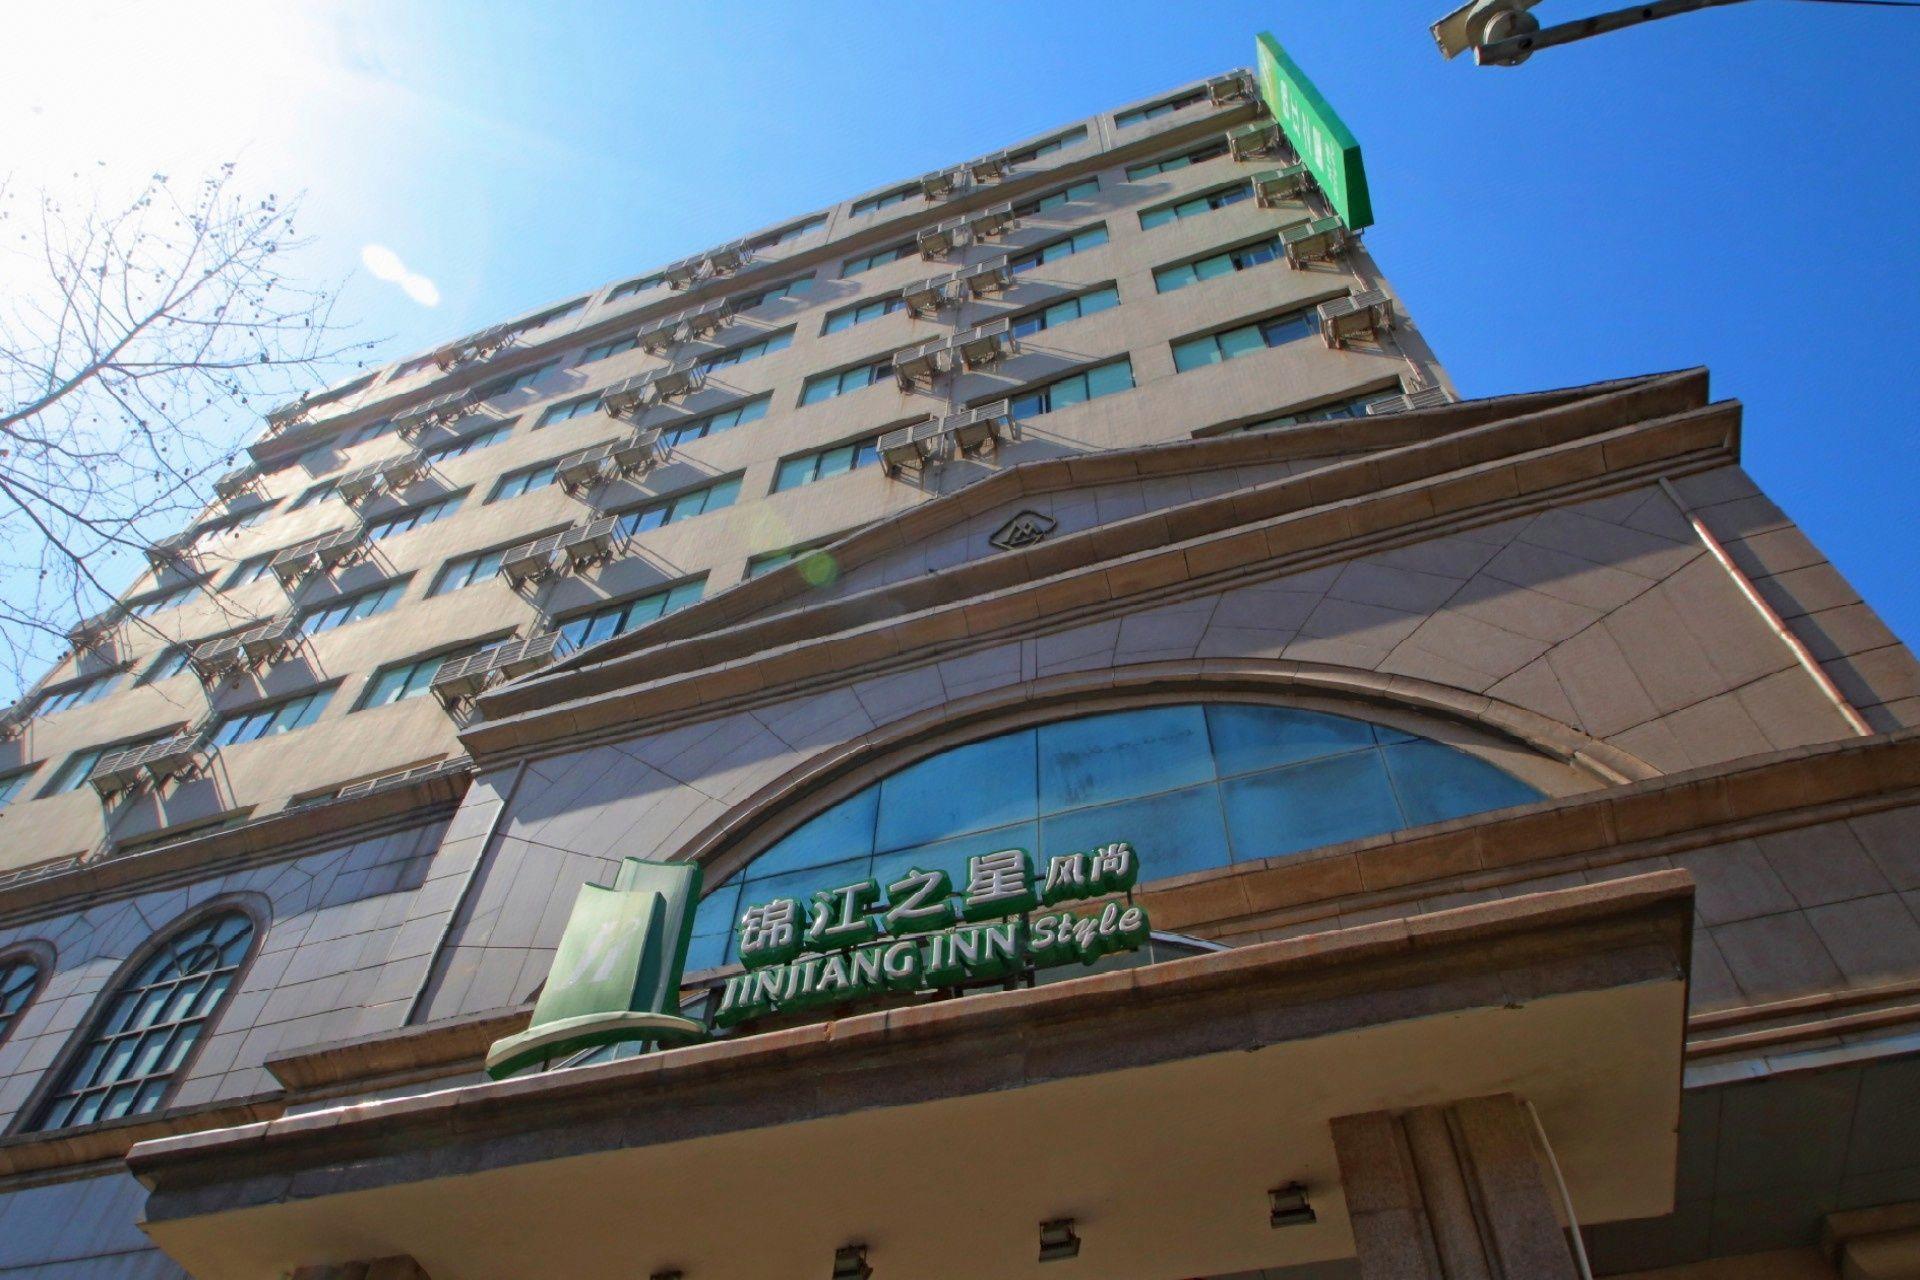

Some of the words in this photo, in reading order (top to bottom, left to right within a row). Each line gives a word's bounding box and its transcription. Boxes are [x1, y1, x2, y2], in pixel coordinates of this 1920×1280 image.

[719, 940, 914, 1011] JINJIANG
[932, 924, 1016, 970] INN
[1031, 903, 1143, 949] Style
